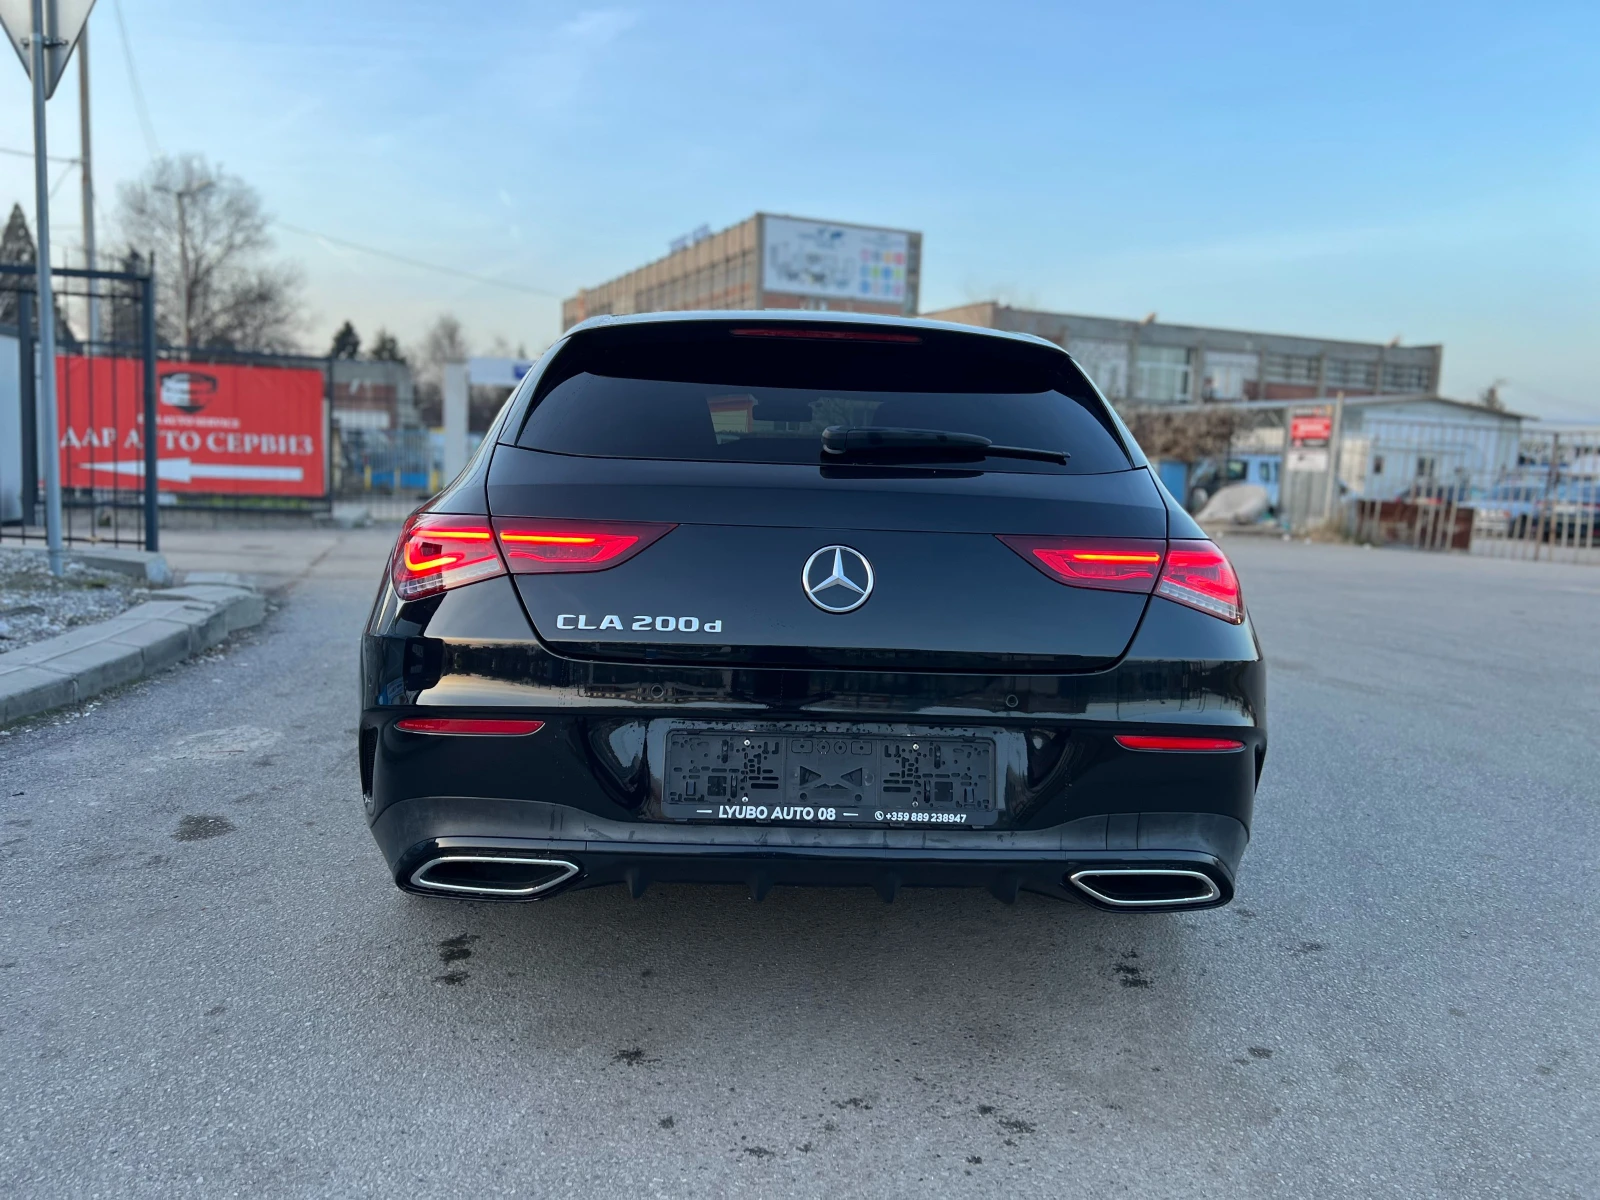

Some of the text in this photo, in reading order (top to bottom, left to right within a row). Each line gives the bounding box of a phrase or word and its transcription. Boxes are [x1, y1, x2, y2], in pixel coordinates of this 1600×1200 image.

[124, 428, 201, 452] АТО
[206, 432, 314, 456] СЕРВИЗ
[556, 614, 624, 630] CLA
[718, 805, 836, 821] LYUBO AUTO 08
[885, 812, 967, 824] +359 889 238947
